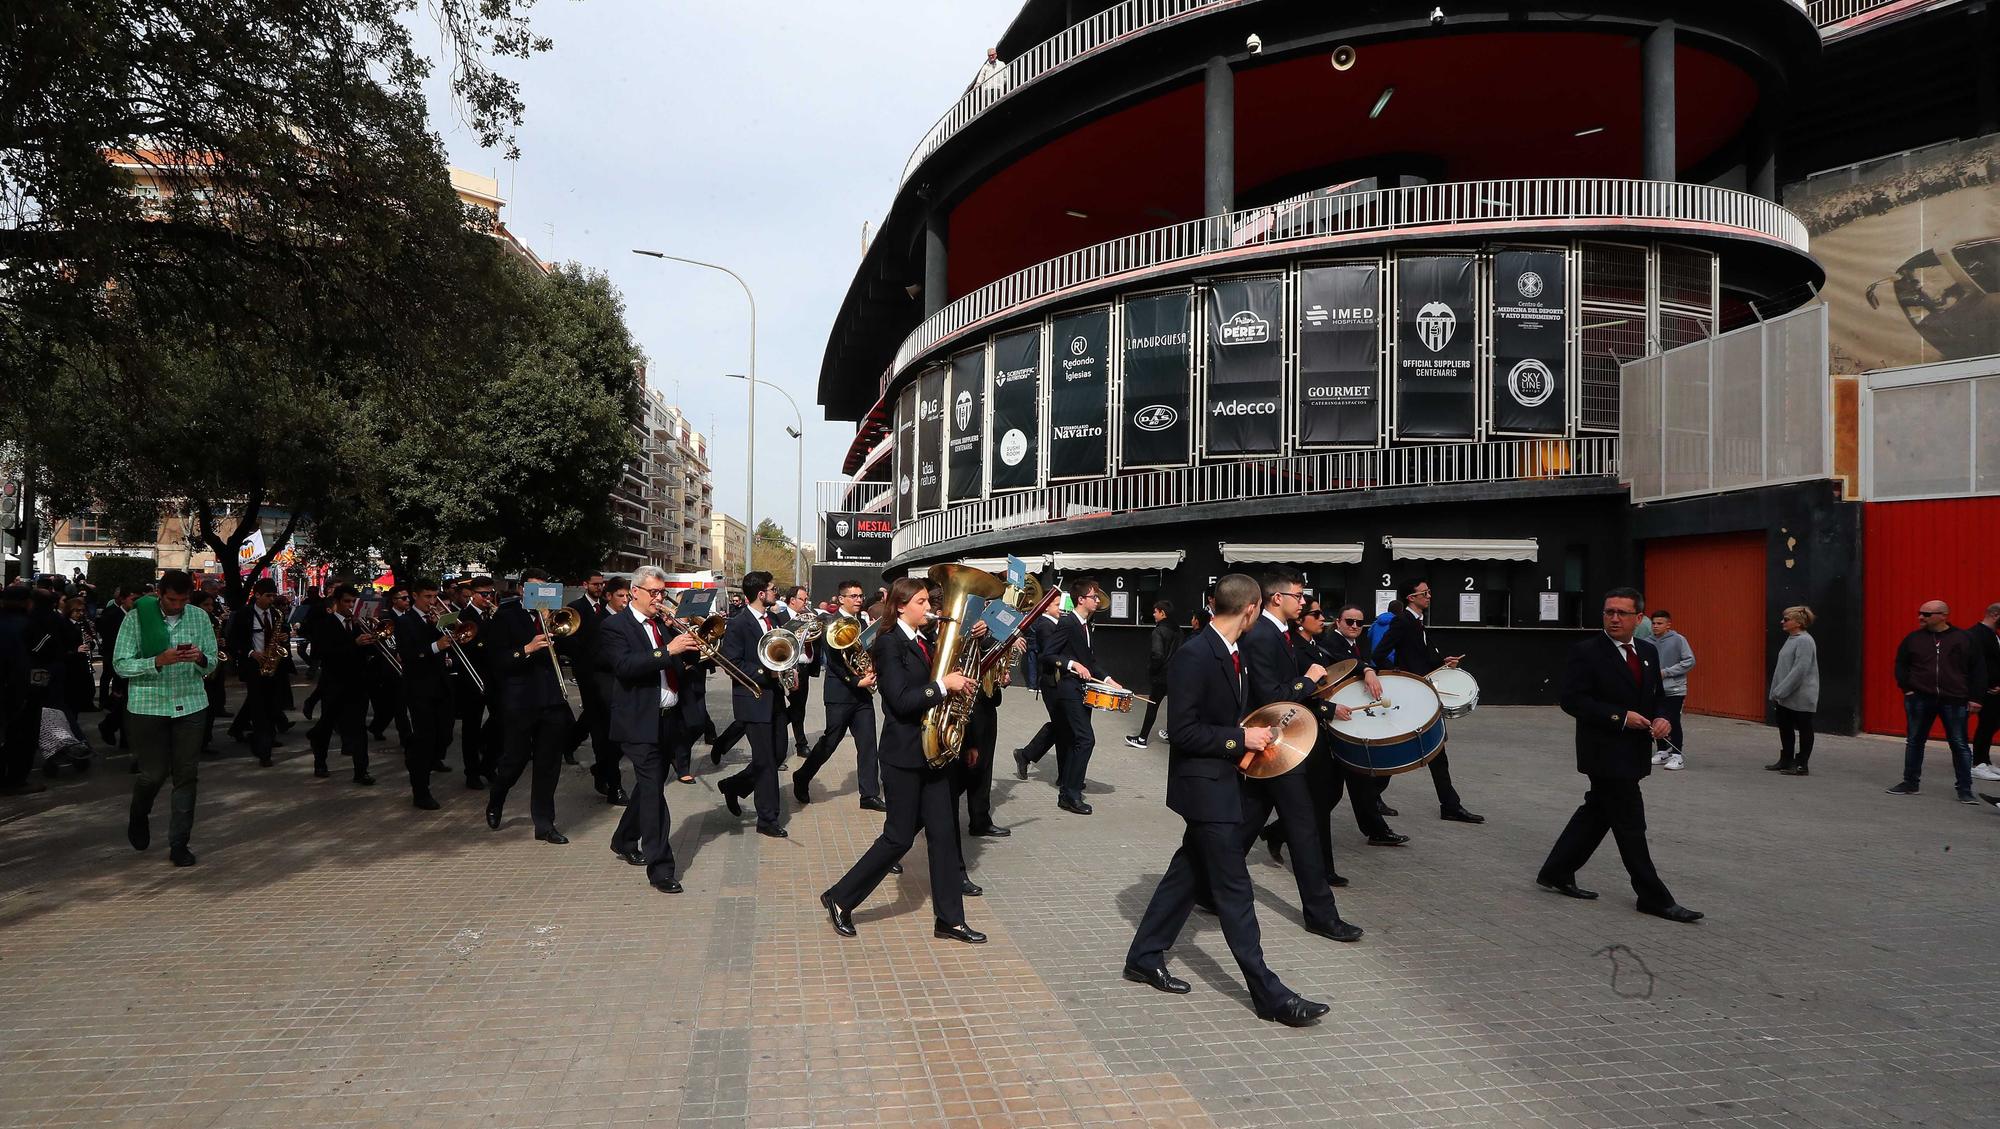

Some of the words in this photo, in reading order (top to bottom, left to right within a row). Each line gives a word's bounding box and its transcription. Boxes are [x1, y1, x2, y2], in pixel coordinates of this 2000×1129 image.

[1332, 308, 1374, 319] IMED
[1224, 326, 1265, 338] PÉREZ
[1063, 356, 1095, 369] Redondo
[1434, 360, 1471, 368] SUPPLIERS
[1416, 368, 1457, 376] CENTENARIS
[1522, 372, 1540, 382] SKY
[1308, 386, 1370, 397] GOURMET
[928, 399, 938, 414] LG
[1213, 400, 1275, 416] Adecco
[1054, 427, 1102, 440] Navarro
[921, 475, 937, 486] nature
[1116, 576, 1124, 589] 6
[1382, 573, 1391, 587] 3
[1464, 577, 1474, 590] 2
[1546, 576, 1552, 589] 1
